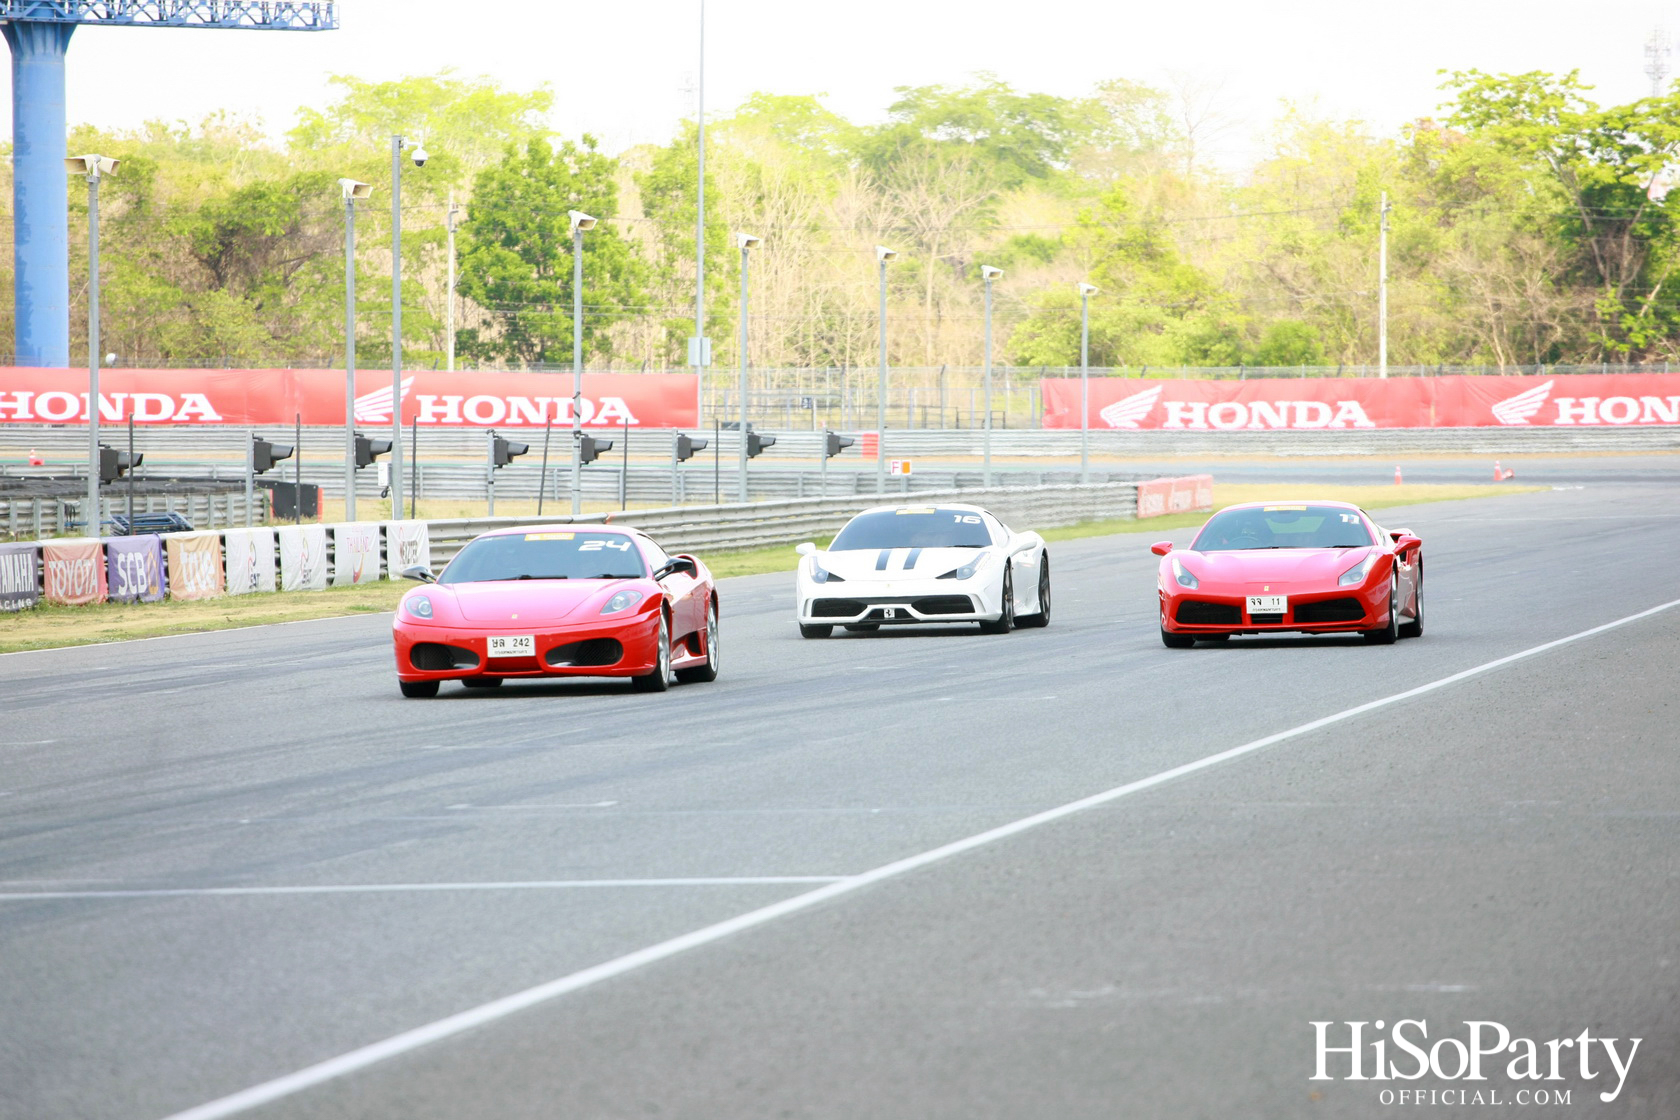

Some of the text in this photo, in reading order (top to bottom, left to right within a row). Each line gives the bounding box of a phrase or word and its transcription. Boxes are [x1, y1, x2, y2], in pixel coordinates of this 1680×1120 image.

[0, 391, 223, 421] HONDA
[415, 395, 640, 424] HONDA
[1163, 401, 1376, 429] HONDA
[1553, 396, 1680, 424] HON
[892, 461, 900, 473] F
[953, 514, 981, 524] 16
[578, 540, 632, 552] 24
[0, 553, 35, 594] AMAHA
[48, 558, 99, 597] TOYOTA
[117, 552, 148, 596] SCB
[0, 598, 32, 610] CING
[1271, 597, 1280, 606] 11
[512, 637, 530, 648] 242
